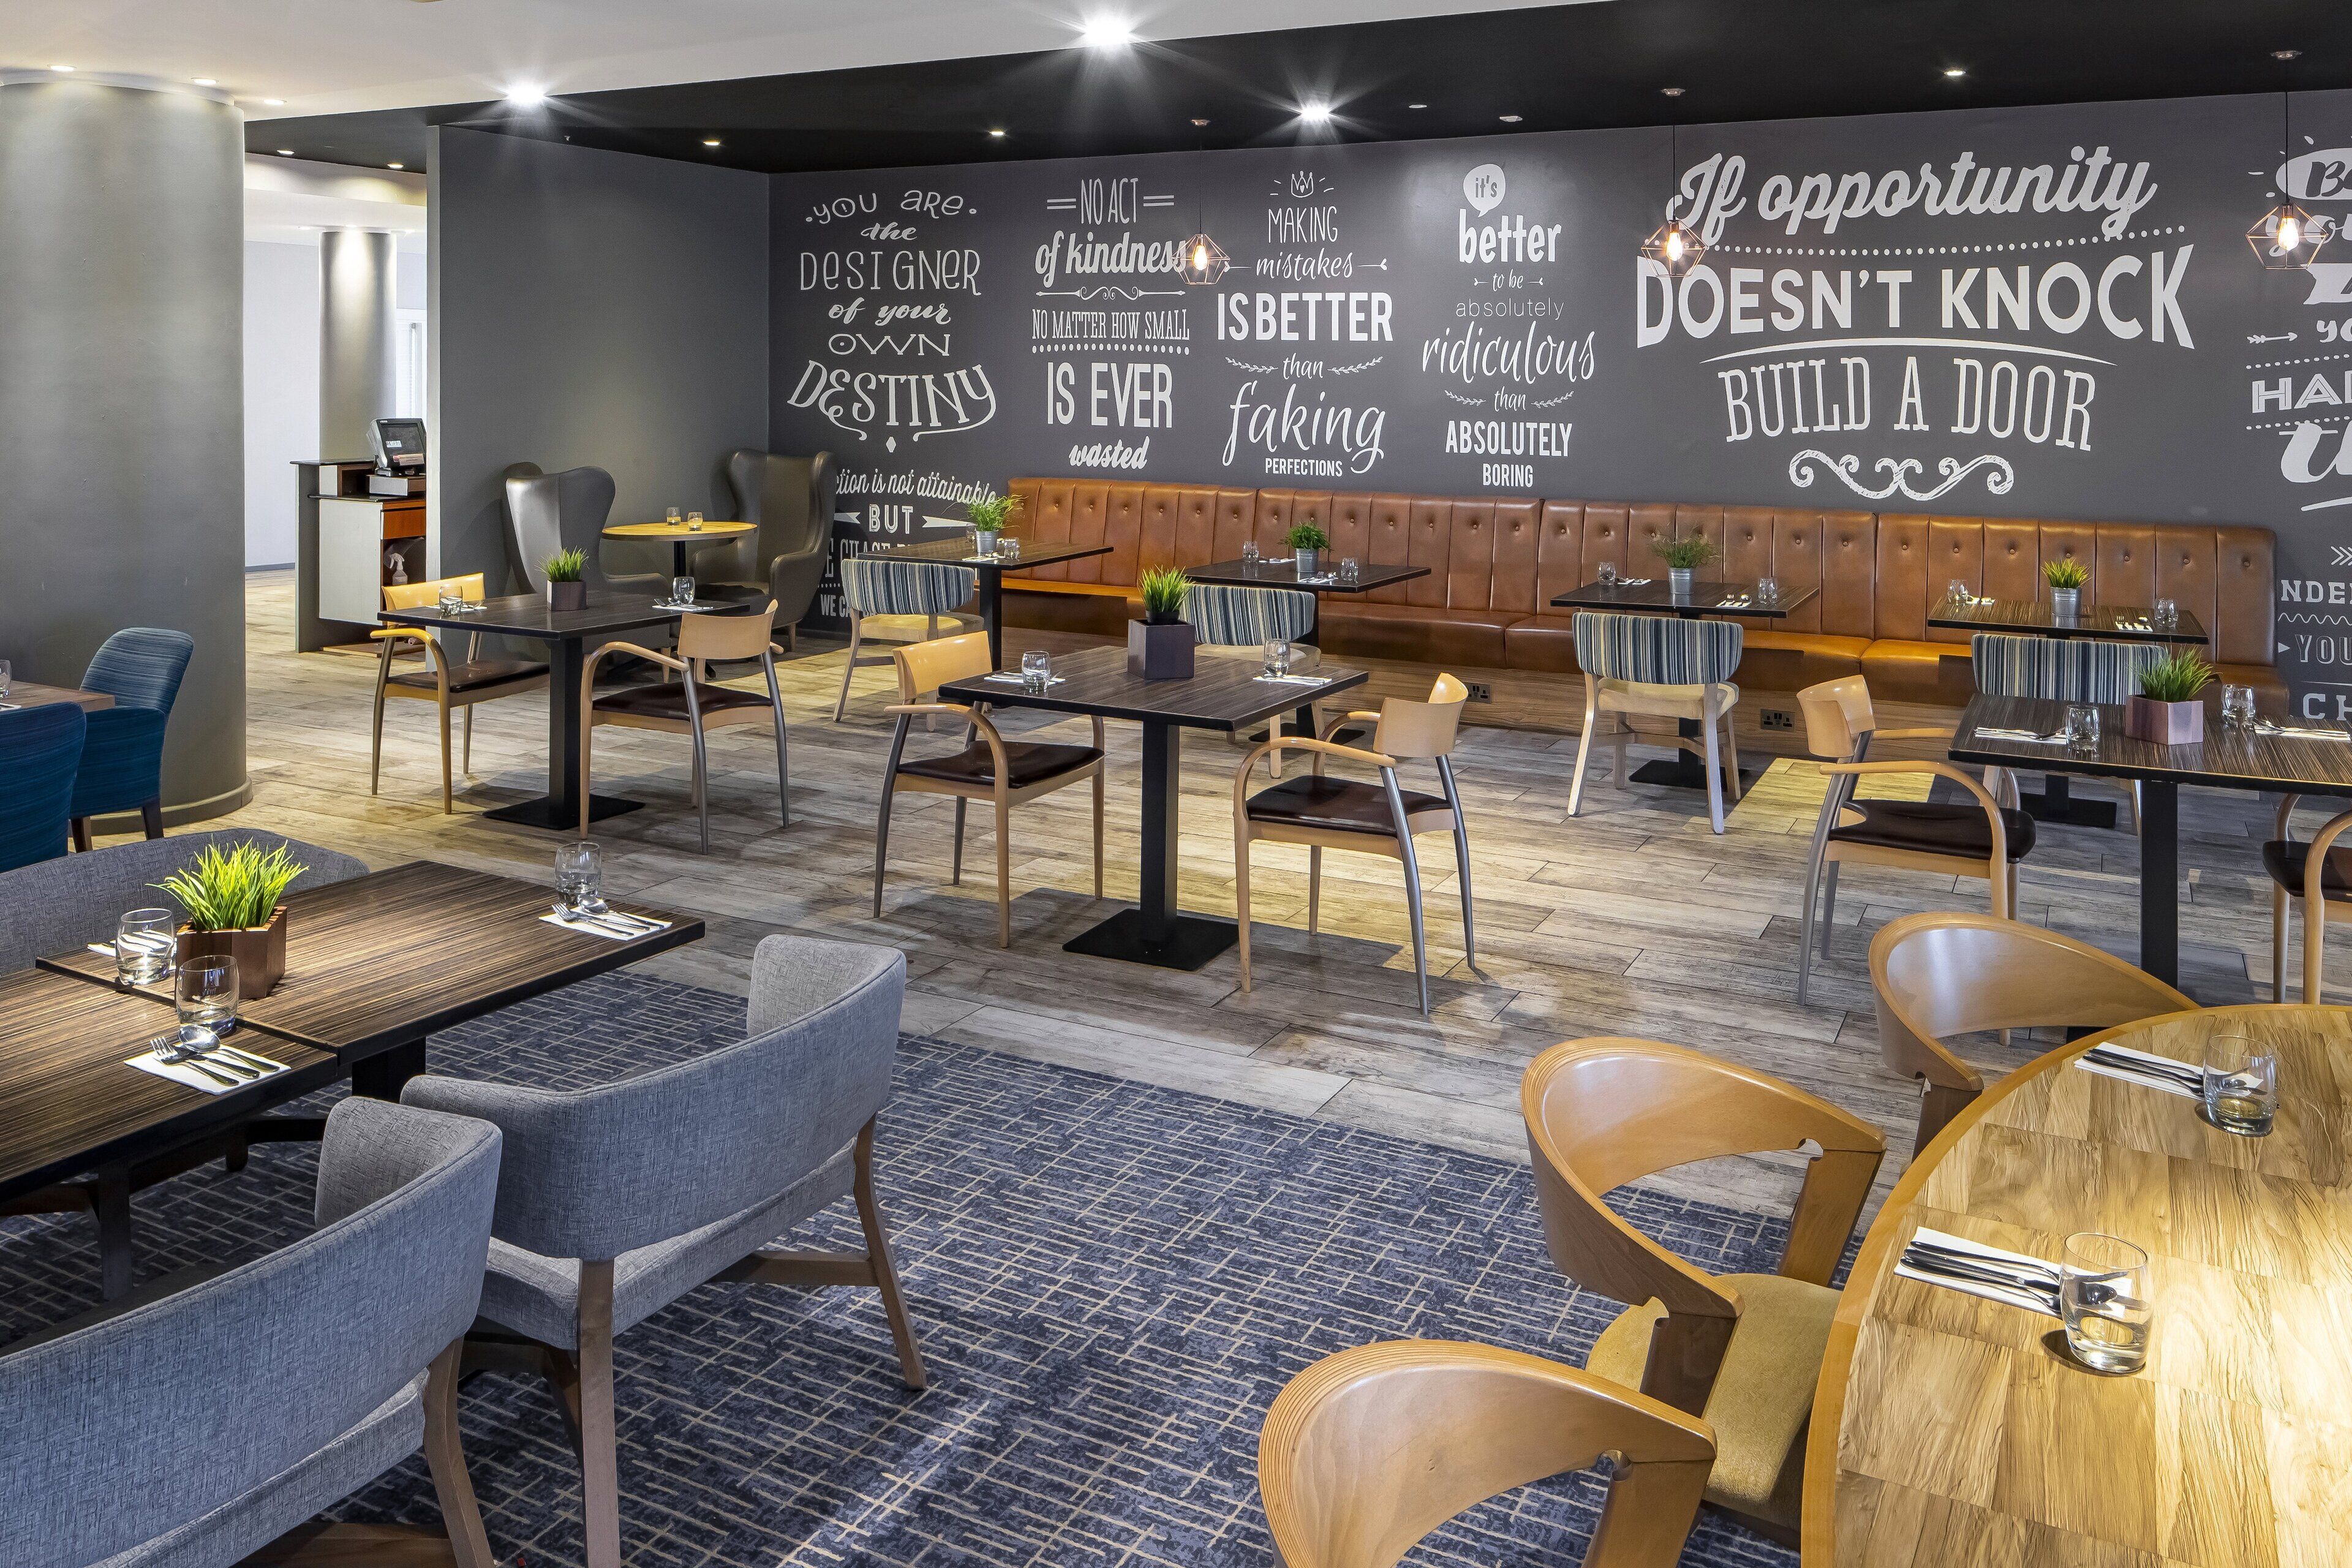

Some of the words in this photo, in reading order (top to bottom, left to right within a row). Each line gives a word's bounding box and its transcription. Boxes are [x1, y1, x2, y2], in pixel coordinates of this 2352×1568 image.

[1080, 178, 1103, 225] NO
[1107, 178, 1139, 224] ACT
[1474, 174, 1499, 199] it's
[1666, 153, 1747, 246] If
[1757, 145, 2158, 236] opportunity
[860, 221, 918, 241] the
[1268, 206, 1338, 244] MAKING
[1459, 206, 1562, 264] better
[1035, 230, 1065, 288] of
[1065, 230, 1187, 275] kindness
[1256, 247, 1353, 281] mistakes
[1493, 273, 1505, 291] to
[1509, 268, 1524, 289] be
[1637, 255, 1912, 349] DOESN'T
[1937, 241, 2195, 351] KNOCK
[828, 296, 866, 325] of
[874, 303, 951, 326] your
[1031, 309, 1047, 339] NO
[1052, 311, 1107, 339] MATTER
[1111, 311, 1140, 339] HOW
[1145, 308, 1189, 341] SMALL
[1218, 292, 1249, 341] IS
[1256, 292, 1393, 341] BETTER
[1455, 297, 1564, 320] absolutely
[828, 333, 951, 356] OWN
[1422, 320, 1595, 385] ridiculous
[1283, 352, 1324, 380] than
[786, 360, 997, 443] DESTINY
[1047, 362, 1075, 424] IS
[1091, 362, 1172, 428] EVER
[1494, 385, 1526, 412] than
[1717, 356, 1871, 442] BUILD
[1893, 356, 1929, 431] A
[1951, 356, 2097, 452] DOOR
[1222, 380, 1386, 477] faking
[1445, 420, 1572, 457] ABSOLUTELY
[1068, 435, 1150, 470] wasted
[1264, 458, 1343, 477] PERFECTIONS
[872, 468, 886, 494] is
[887, 469, 914, 495] not
[1483, 463, 1533, 488] BORING
[869, 503, 913, 535] BUT
[820, 594, 836, 617] WE
[2281, 579, 2352, 605] NDE
